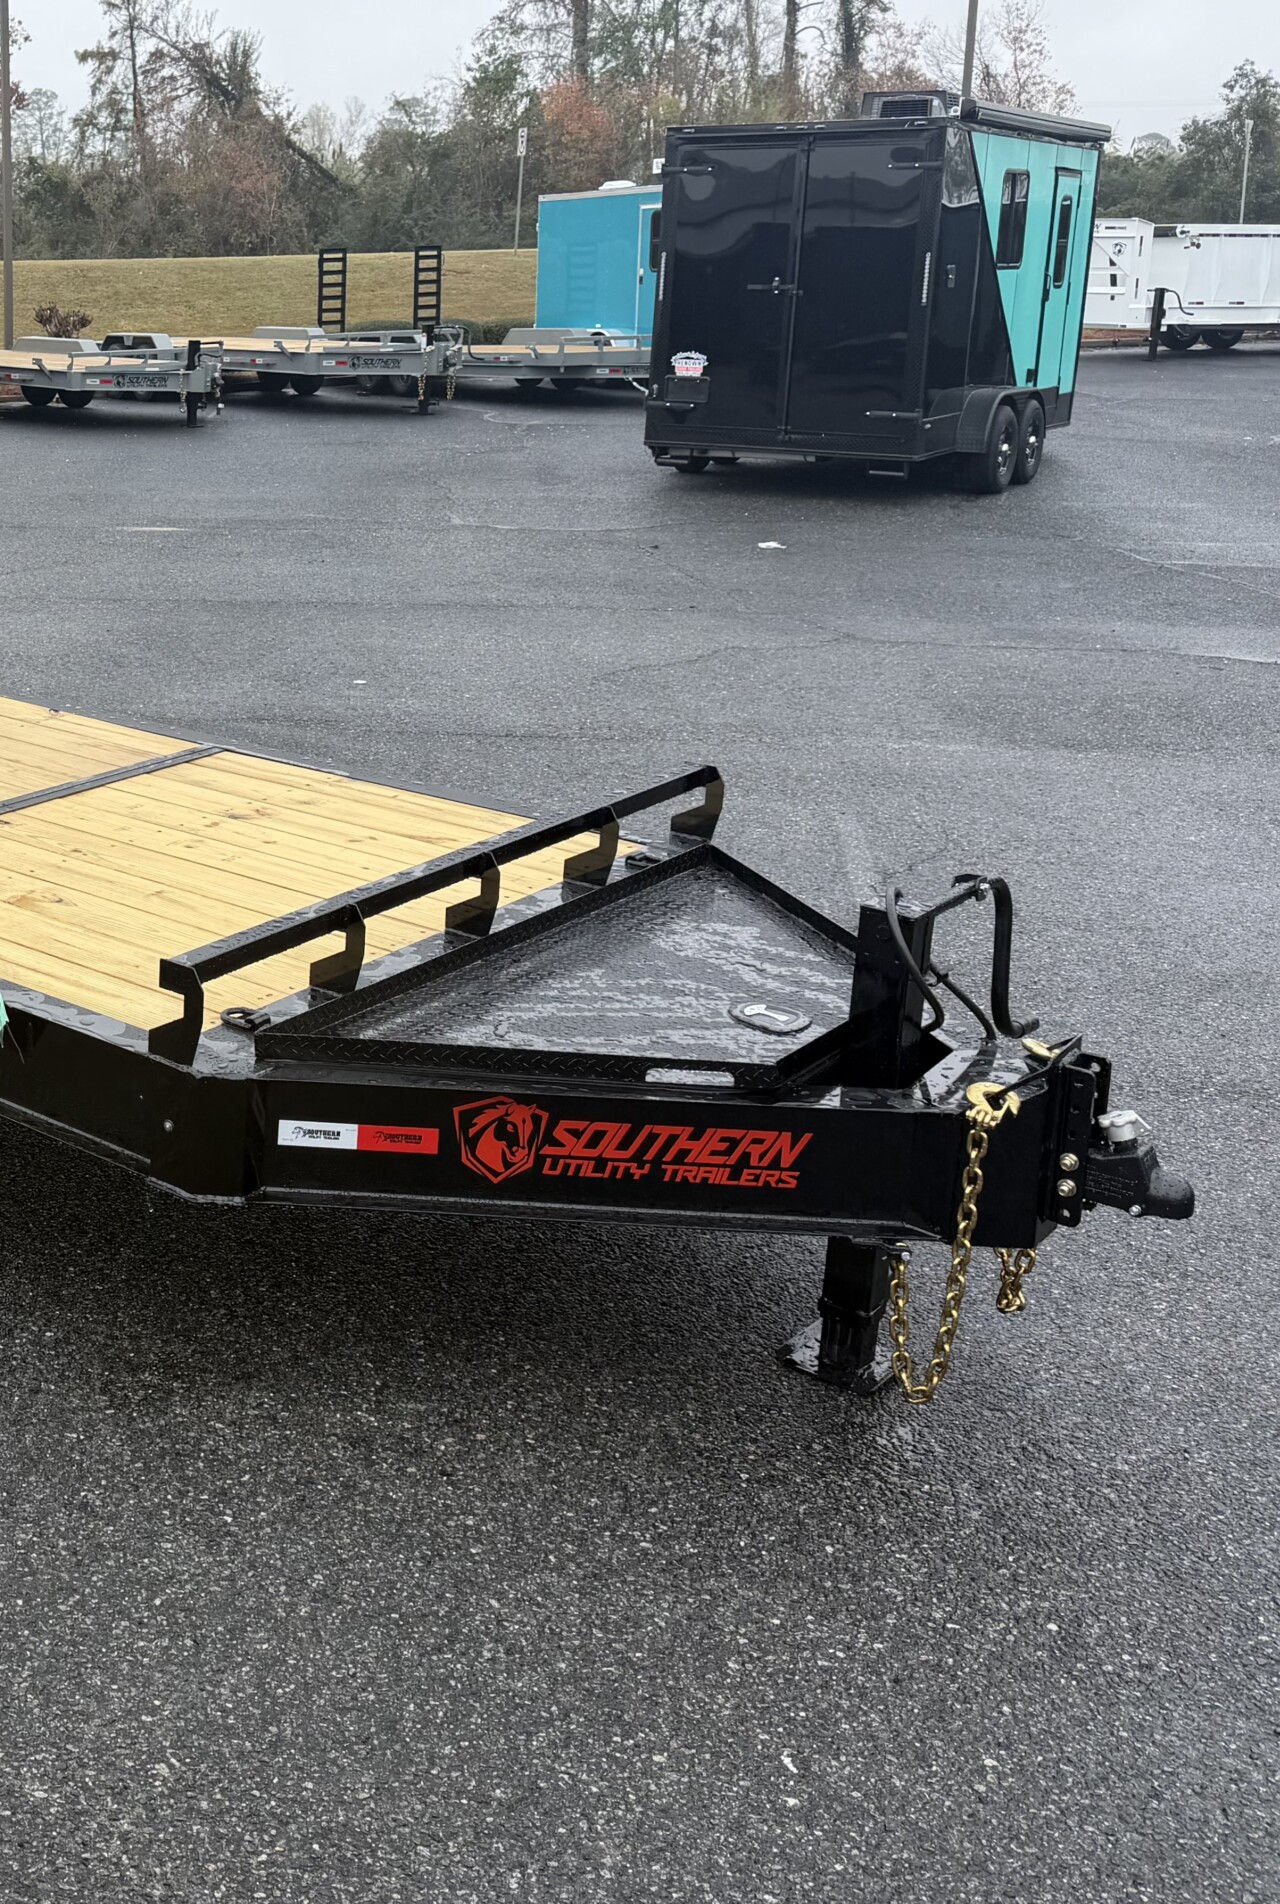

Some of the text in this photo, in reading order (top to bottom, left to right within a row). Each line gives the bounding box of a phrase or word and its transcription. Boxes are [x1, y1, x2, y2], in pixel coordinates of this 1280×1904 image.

[539, 1120, 814, 1168] SOUTHERN
[542, 1157, 801, 1189] UTILITY TRAILERS
